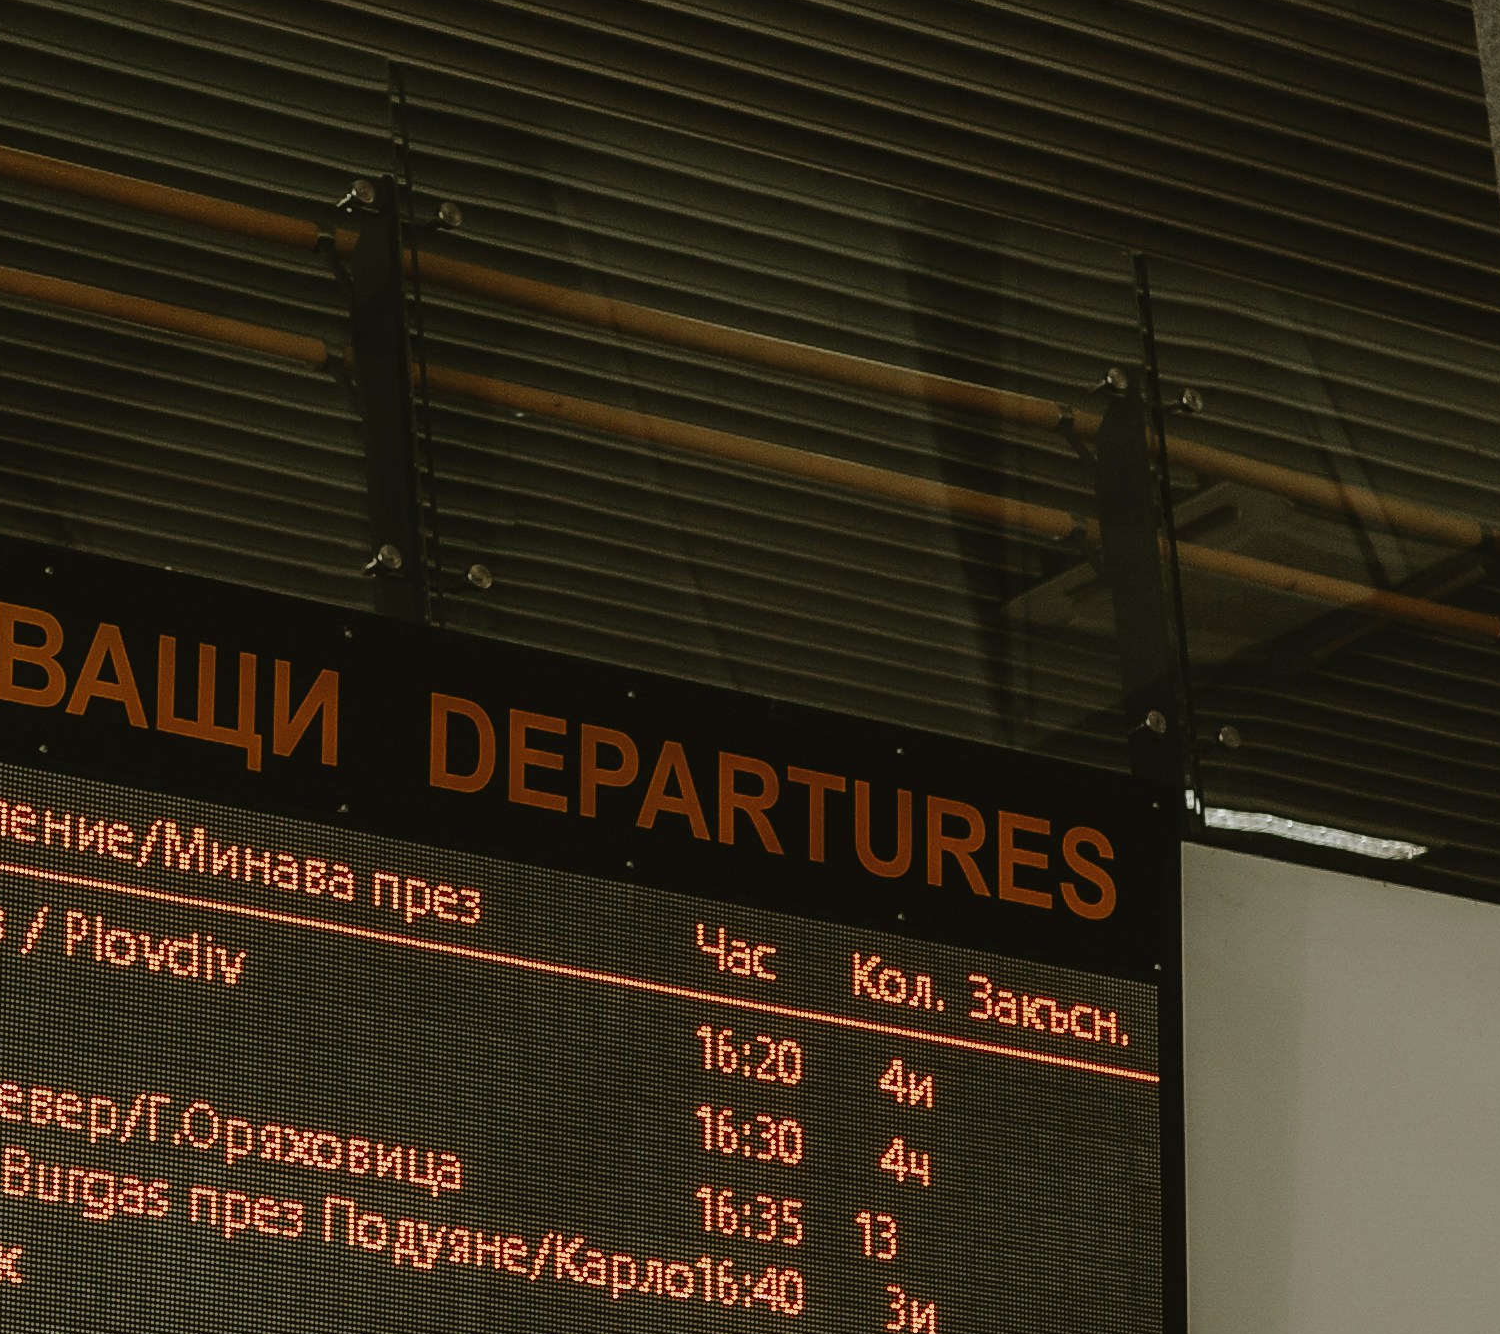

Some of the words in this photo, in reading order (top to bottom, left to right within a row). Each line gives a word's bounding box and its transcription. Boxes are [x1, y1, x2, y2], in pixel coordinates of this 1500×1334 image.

[428, 692, 1117, 920] DEPARTURES
[66, 910, 247, 985] Plovdiv
[696, 1025, 803, 1086] 16:20
[371, 872, 481, 925] през
[696, 923, 777, 981] Час
[852, 951, 945, 1012] Кол.
[968, 973, 1129, 1047] Закъсн.
[695, 1105, 803, 1166] 16:30
[0, 1147, 172, 1221] Burgas
[188, 1184, 307, 1239] през
[696, 1255, 806, 1316] 16:40
[695, 1185, 803, 1246] 16:35
[854, 1211, 897, 1260] 13
